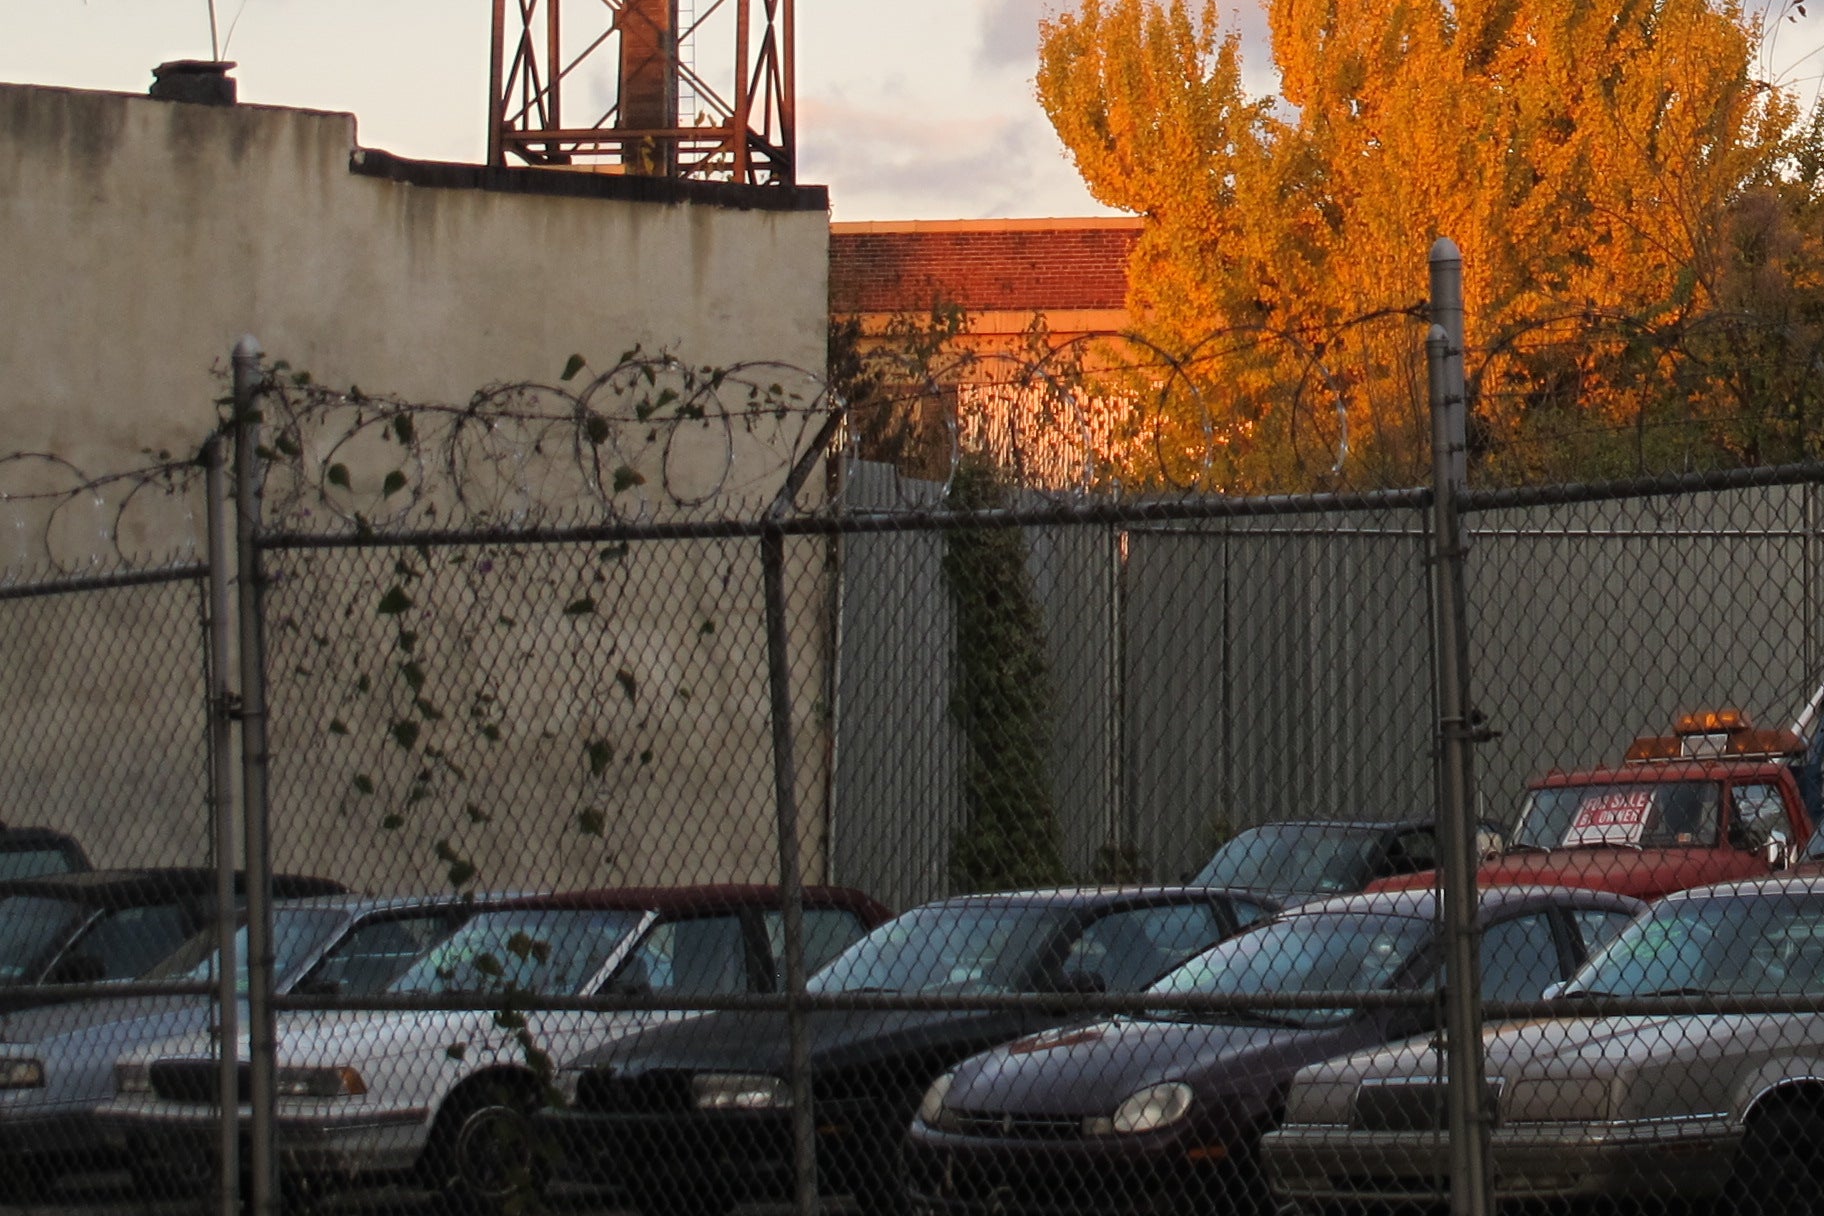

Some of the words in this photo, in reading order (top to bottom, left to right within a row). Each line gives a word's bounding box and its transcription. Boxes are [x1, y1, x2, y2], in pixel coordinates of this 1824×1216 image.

[1585, 795, 1609, 811] FOR
[1610, 792, 1648, 808] SALE
[1598, 808, 1641, 824] OWNER
